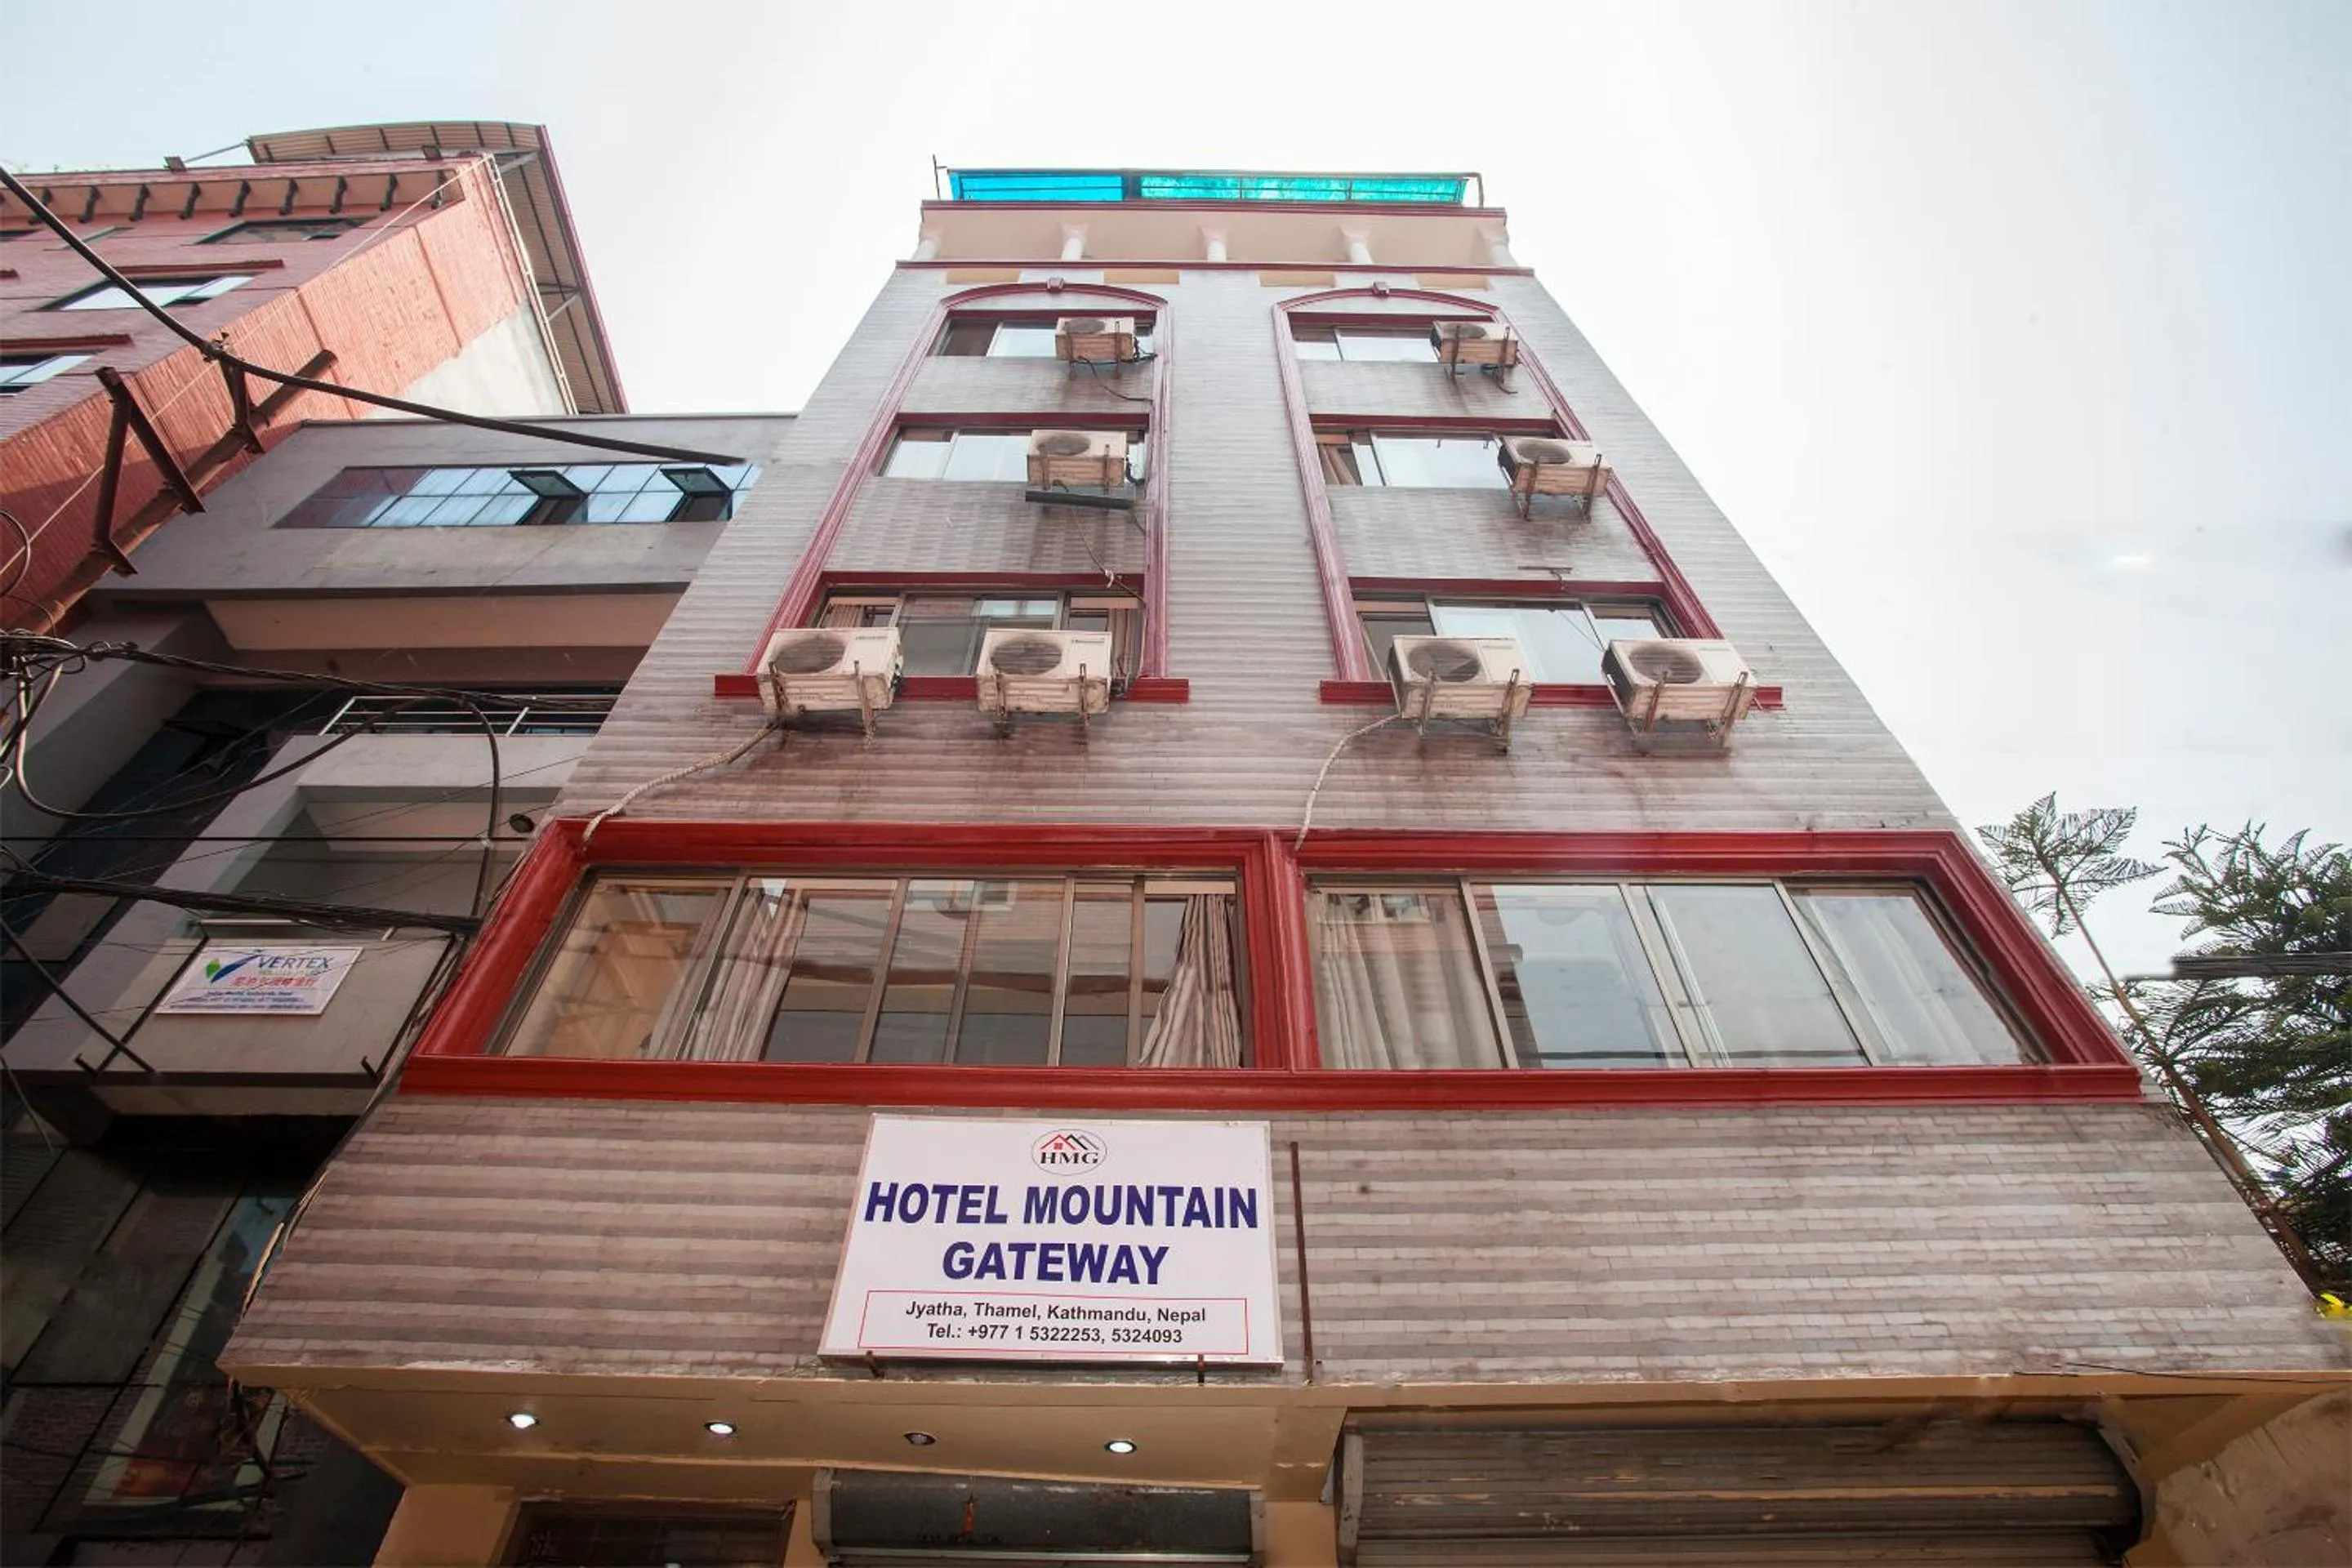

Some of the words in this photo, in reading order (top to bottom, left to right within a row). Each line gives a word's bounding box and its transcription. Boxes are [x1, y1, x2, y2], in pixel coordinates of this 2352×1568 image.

[258, 956, 336, 969] VERTEX
[1040, 1151, 1099, 1165] HMG
[864, 1182, 1008, 1225] HOTEL
[1022, 1184, 1258, 1228] MOUNTAIN
[942, 1241, 1169, 1285] GATEWAY
[906, 1301, 967, 1319] Jyatha,
[974, 1303, 1041, 1321] Thamel,
[1047, 1304, 1152, 1324] Kathmandu,
[1157, 1307, 1206, 1325] Nepal
[928, 1323, 961, 1339] Tel.:
[968, 1324, 1009, 1339] +977
[1015, 1325, 1023, 1339] 1
[1029, 1326, 1106, 1344] 5322253,
[1111, 1329, 1183, 1343] 5324093
